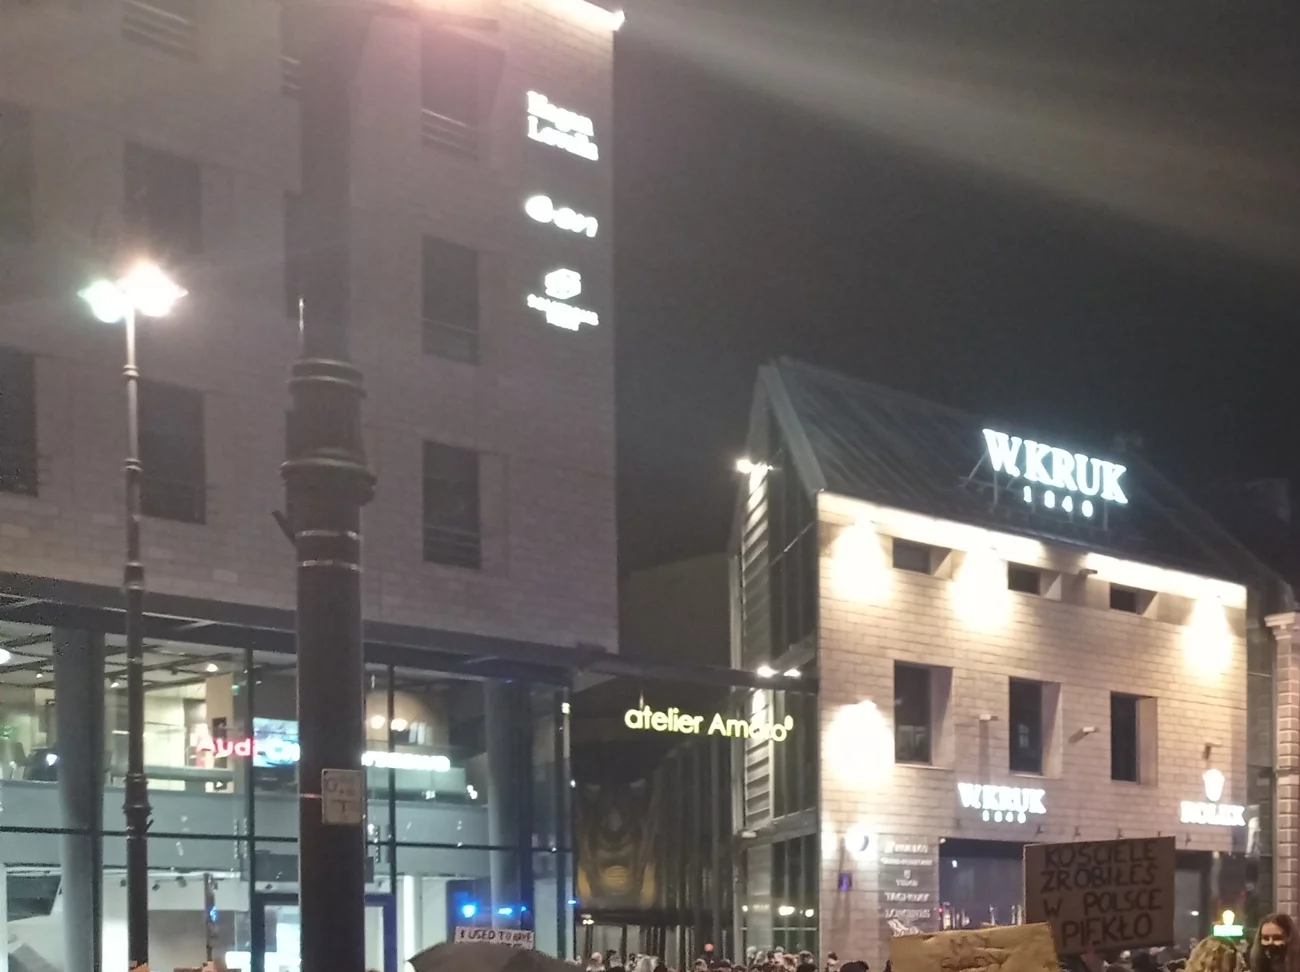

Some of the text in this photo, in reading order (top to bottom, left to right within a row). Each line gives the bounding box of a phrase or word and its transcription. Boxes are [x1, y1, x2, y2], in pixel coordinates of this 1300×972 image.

[624, 705, 704, 734] atelier
[1042, 887, 1163, 917] W POLSCE
[468, 929, 496, 939] USED
[499, 931, 512, 940] TO
